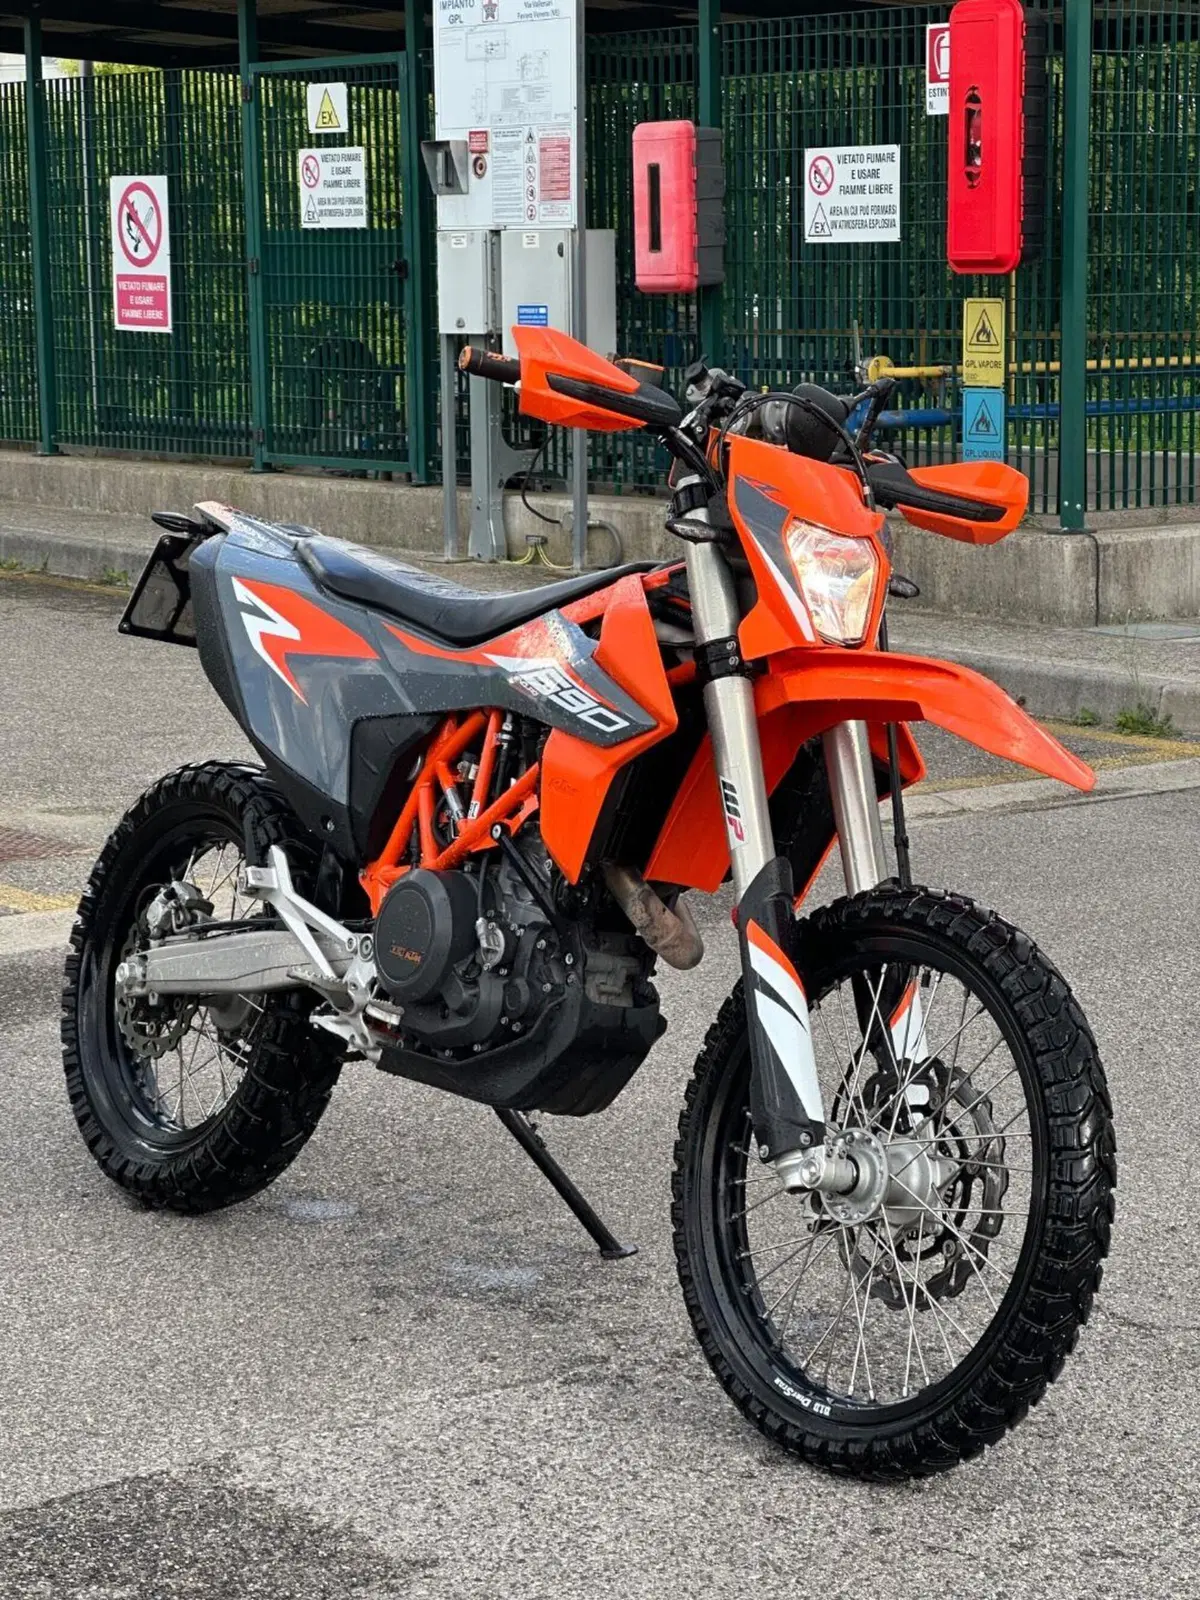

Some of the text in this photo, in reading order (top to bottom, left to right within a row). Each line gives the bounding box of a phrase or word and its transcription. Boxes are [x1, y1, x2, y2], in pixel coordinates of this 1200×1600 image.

[440, 0, 475, 10] IMPIANTO
[448, 14, 463, 24] GPL
[321, 111, 334, 125] EX
[321, 152, 362, 163] VIETATO FUMARE
[837, 152, 896, 165] VIETATO FUMARE
[335, 166, 352, 175] USARE
[851, 168, 881, 179] E USARE
[323, 178, 362, 188] FIAMME LIBERE
[839, 183, 893, 195] FIAMME LIBERE
[829, 205, 843, 216] AREA
[844, 205, 849, 216] IN
[850, 205, 858, 216] CUI
[870, 204, 897, 215] FORMARSI
[307, 211, 316, 221] EX
[814, 222, 826, 234] EX
[869, 218, 896, 229] ESPLOSIVA
[118, 281, 165, 292] VIETATO FUMARE
[129, 295, 154, 306] E USARE
[121, 309, 164, 320] FIAMME LIBERE
[965, 360, 1002, 369] GPL VAPORE
[965, 449, 977, 459] GPL
[516, 666, 631, 733] 690
